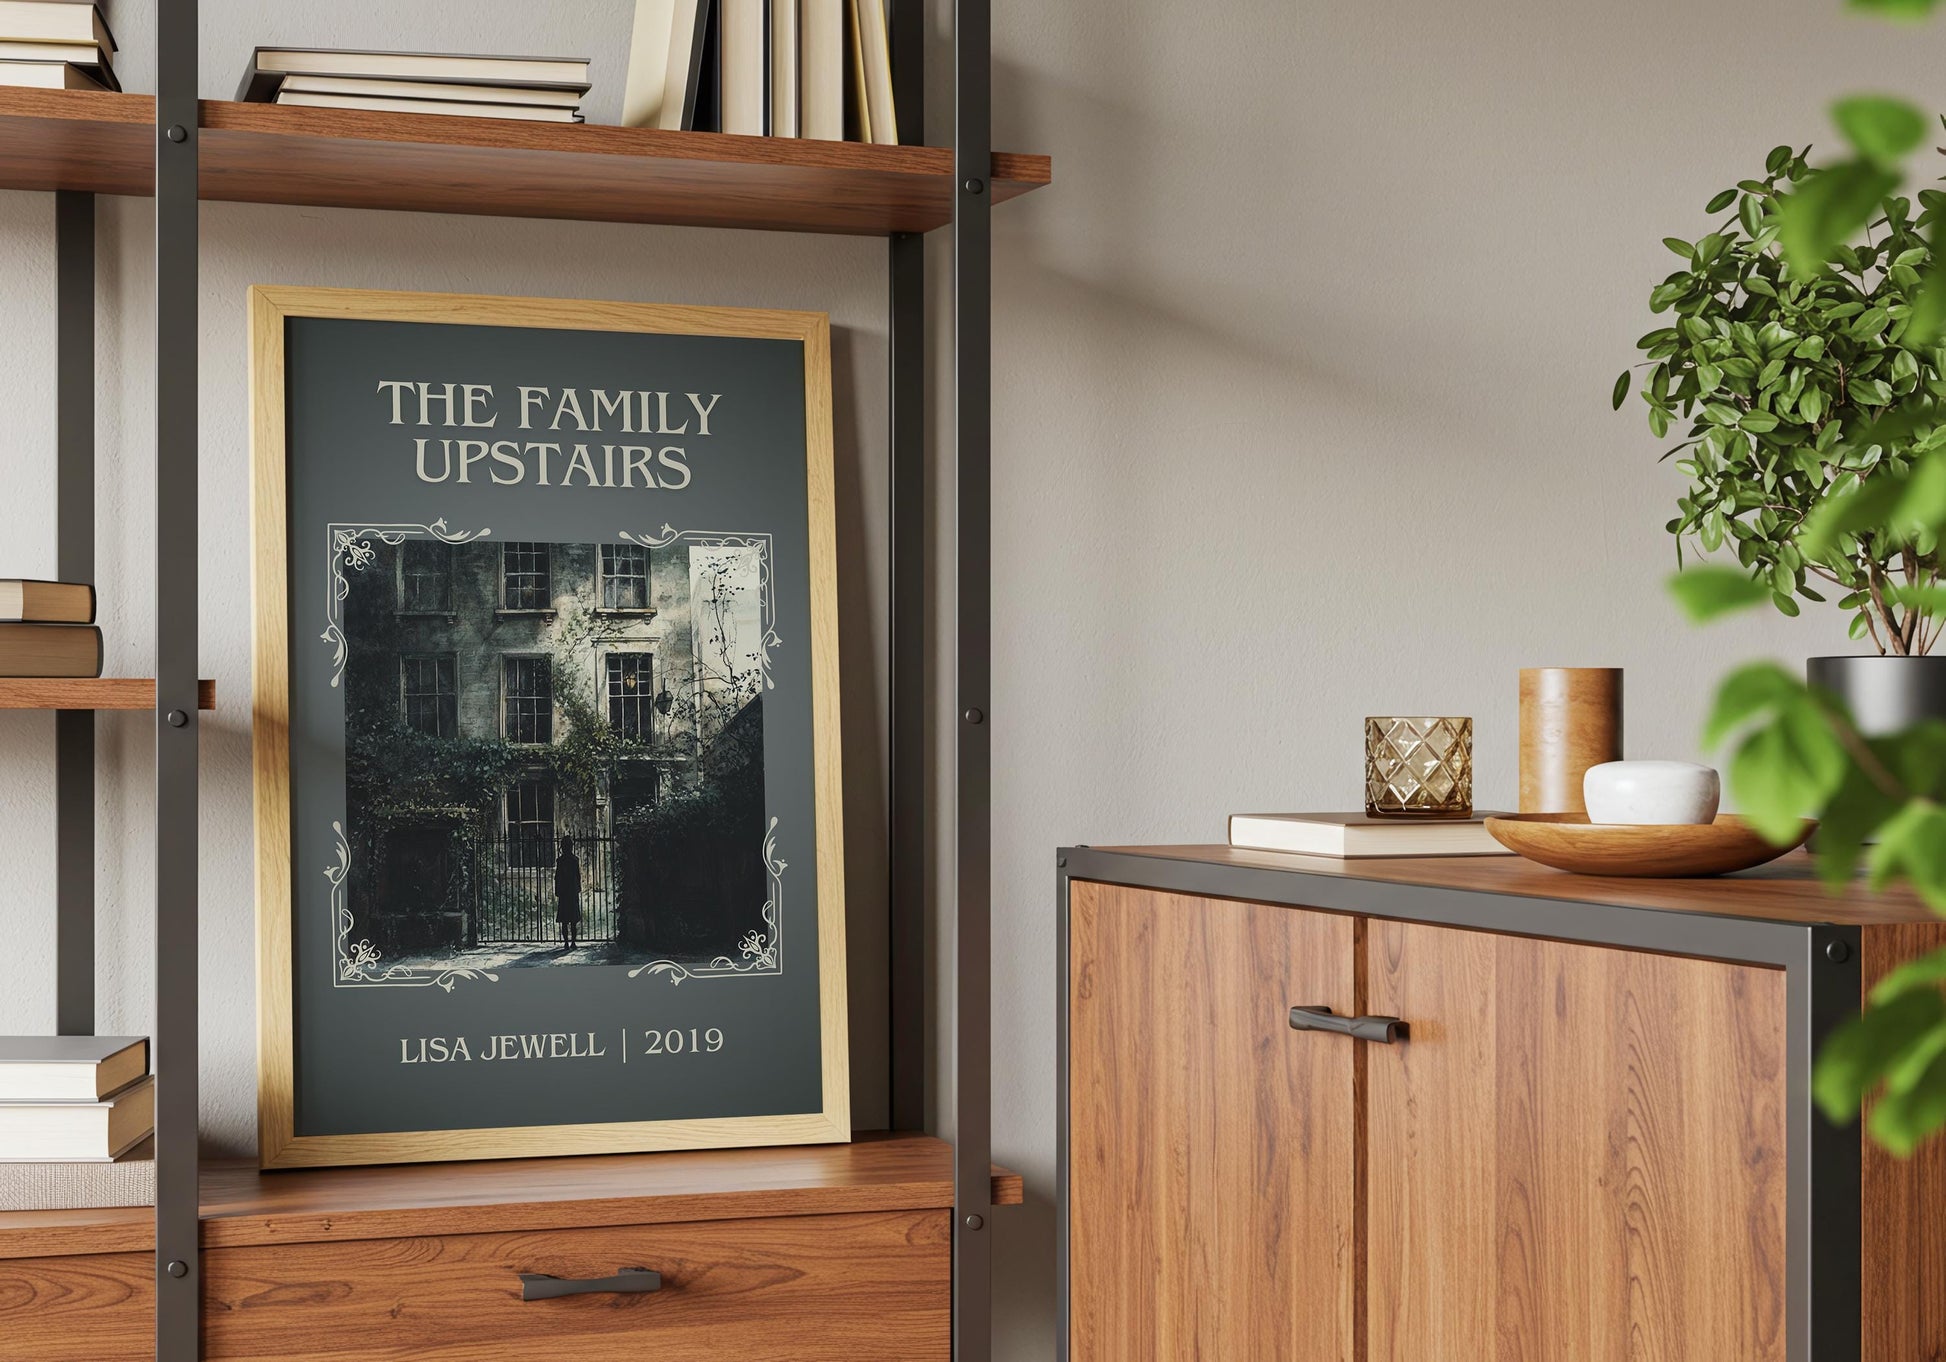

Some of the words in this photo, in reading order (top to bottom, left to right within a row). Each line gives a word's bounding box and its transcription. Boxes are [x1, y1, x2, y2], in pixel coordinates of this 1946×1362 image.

[377, 381, 499, 428] THE
[517, 386, 723, 436] FAMILY
[412, 438, 692, 489] UPSTAIRS
[400, 1037, 473, 1064] LISA
[481, 1033, 607, 1061] JEWELL
[644, 1028, 724, 1055] 2019
